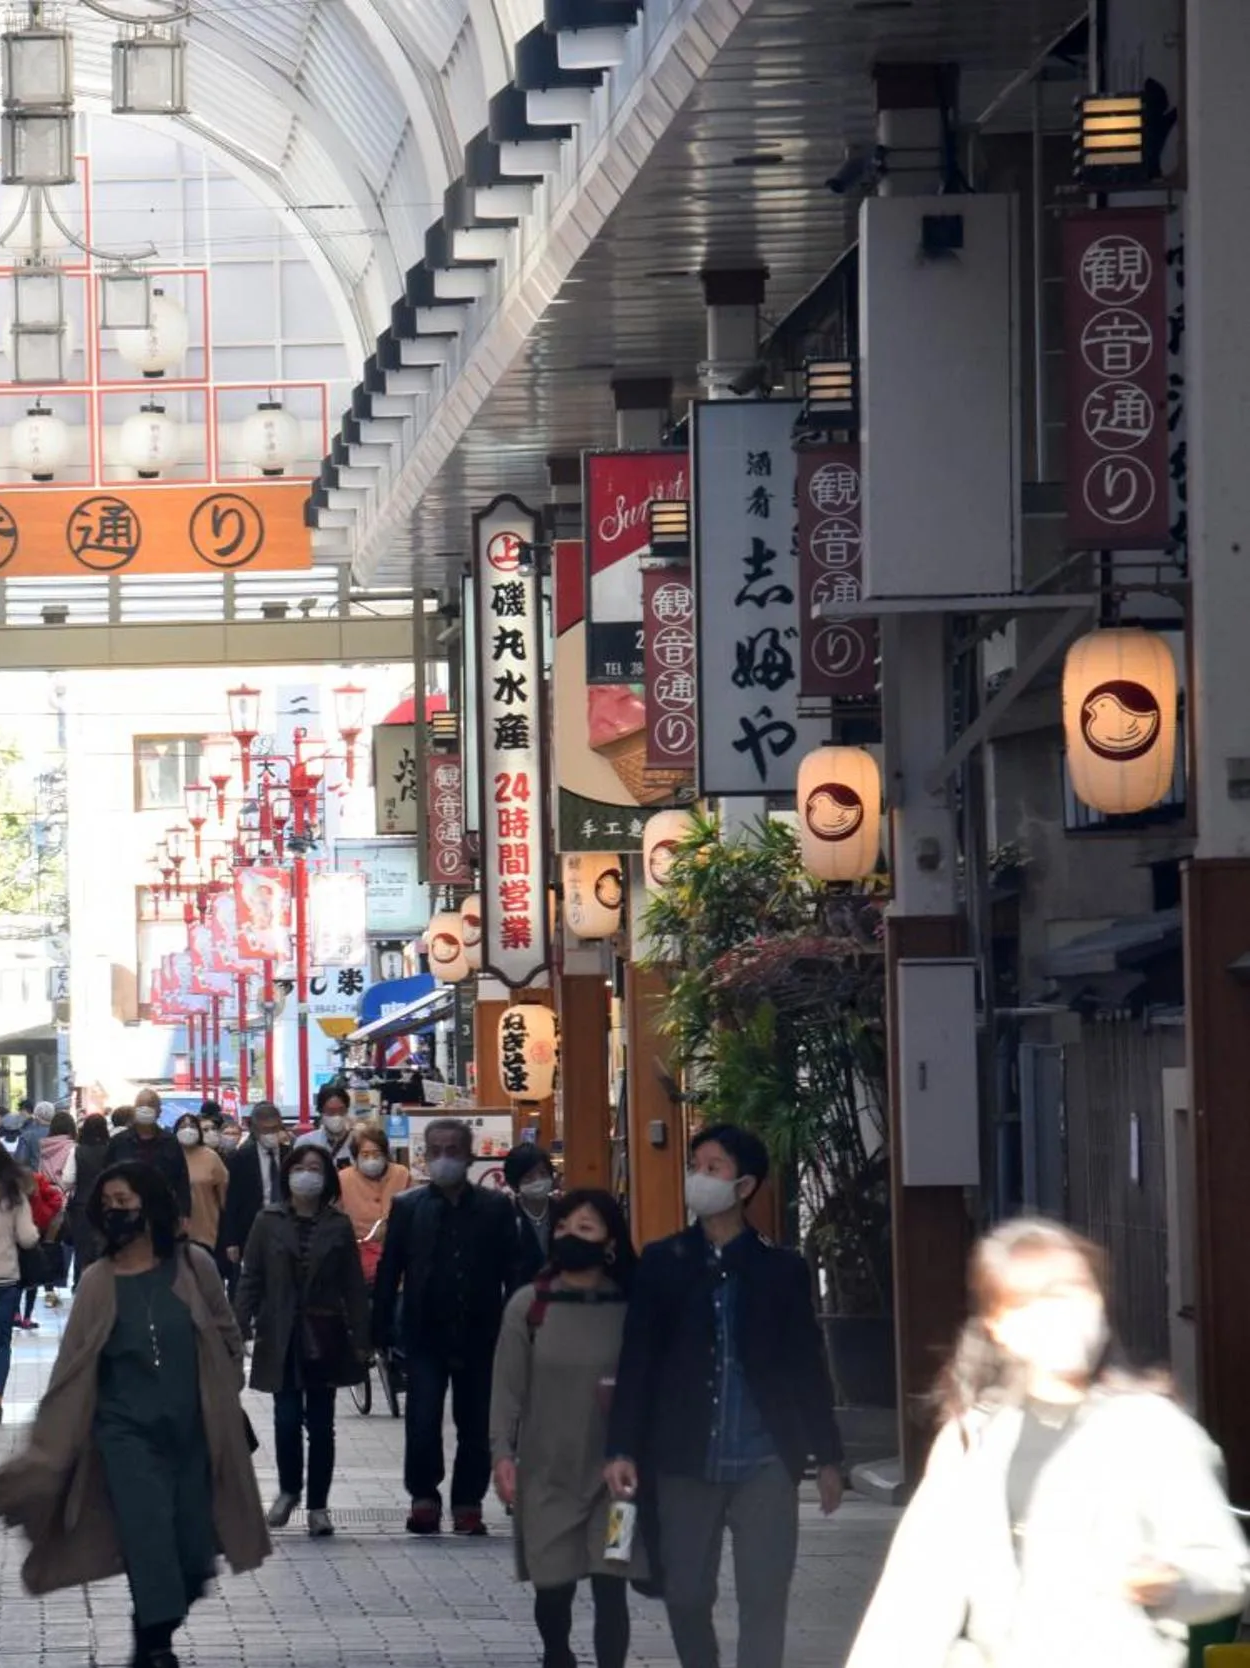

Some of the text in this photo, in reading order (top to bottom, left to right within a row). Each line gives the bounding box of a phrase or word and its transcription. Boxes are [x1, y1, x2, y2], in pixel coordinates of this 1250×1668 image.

[1080, 235, 1155, 524] 観音通り
[809, 463, 865, 677] 観音通り
[491, 581, 530, 751] 磯丸水産
[651, 582, 697, 755] 観音通り
[494, 771, 532, 950] 24時間営業
